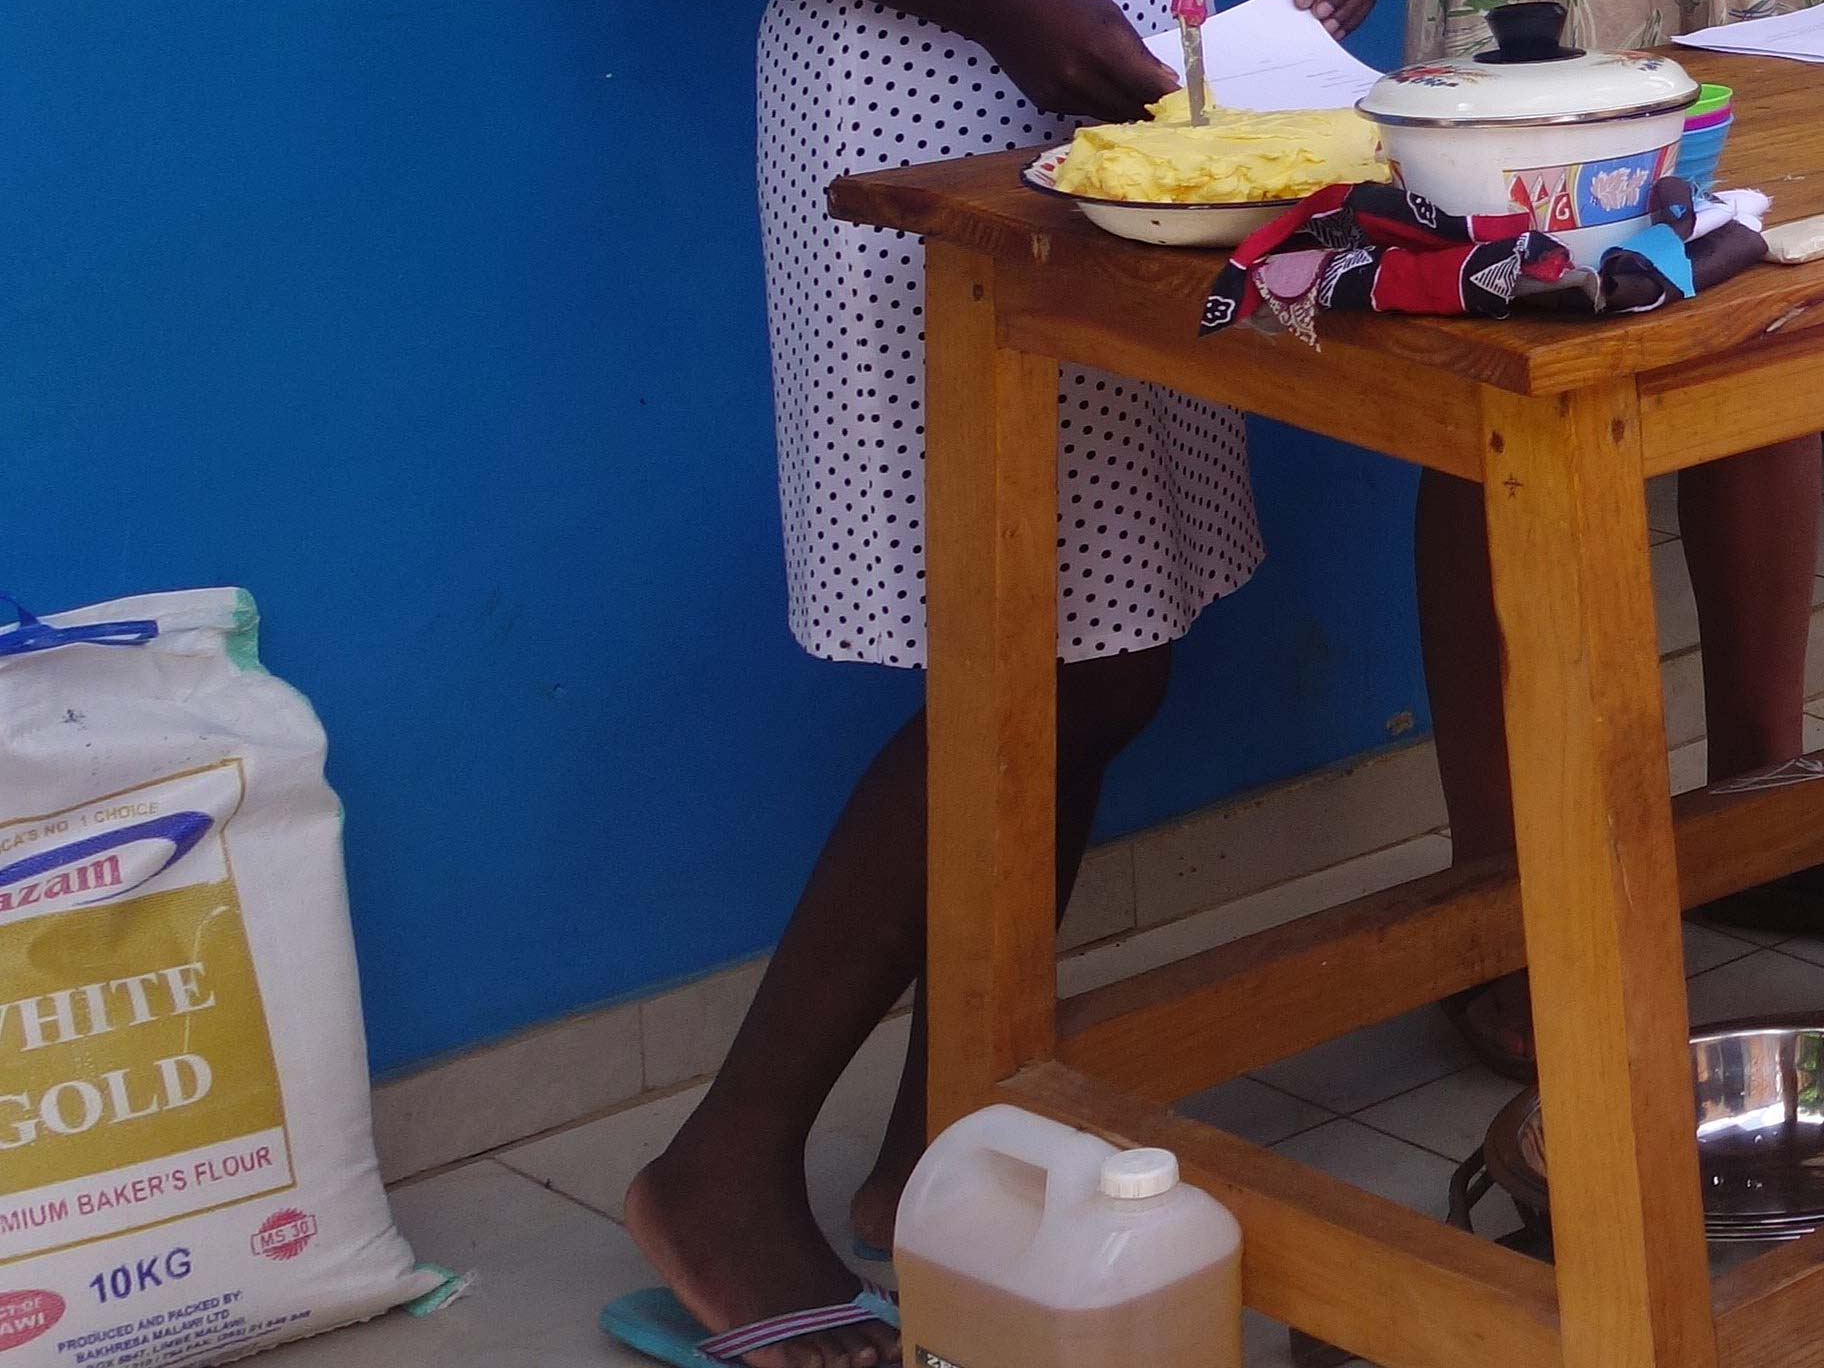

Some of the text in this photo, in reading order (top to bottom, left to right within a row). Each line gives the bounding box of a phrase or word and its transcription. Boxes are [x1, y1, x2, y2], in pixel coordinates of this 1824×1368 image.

[94, 801, 159, 824] CHOICE
[0, 962, 216, 1052] HITE
[0, 1053, 213, 1149] GOLD
[77, 1169, 187, 1216] BAKER'S
[194, 1145, 273, 1187] FLOUR
[261, 1221, 309, 1249] MS 30
[90, 1247, 192, 1304] 10KG
[57, 1324, 135, 1354] PRODUCED
[137, 1314, 166, 1332] AND
[168, 1298, 220, 1322] PACKED
[206, 1309, 230, 1325] LTD
